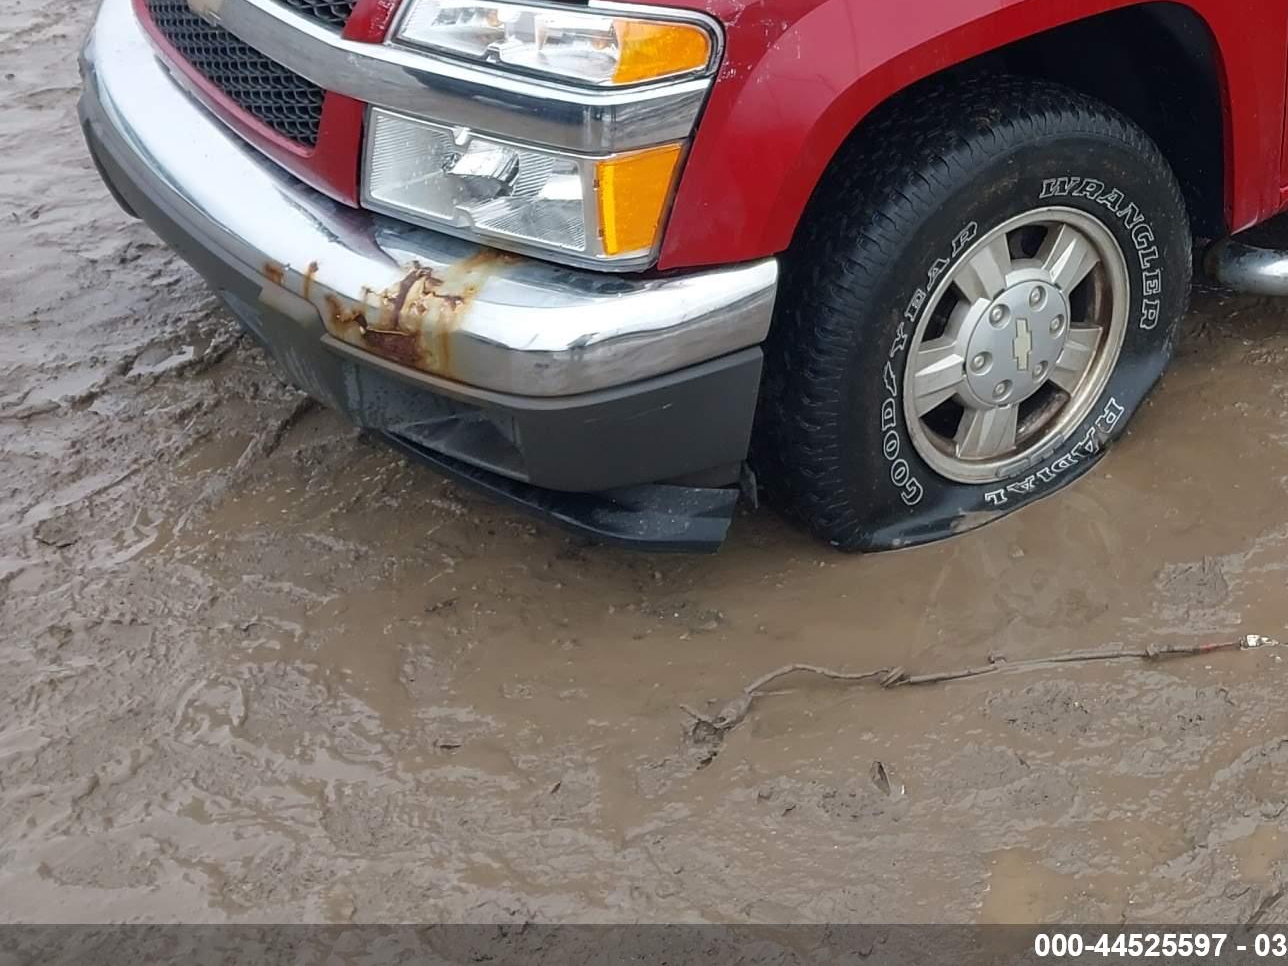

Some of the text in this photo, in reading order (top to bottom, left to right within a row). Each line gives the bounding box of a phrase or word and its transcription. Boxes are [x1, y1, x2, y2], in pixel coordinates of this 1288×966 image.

[1039, 177, 1164, 330] WRANGLER
[881, 221, 979, 506] GOODYEAR
[985, 397, 1126, 505] RADIAL
